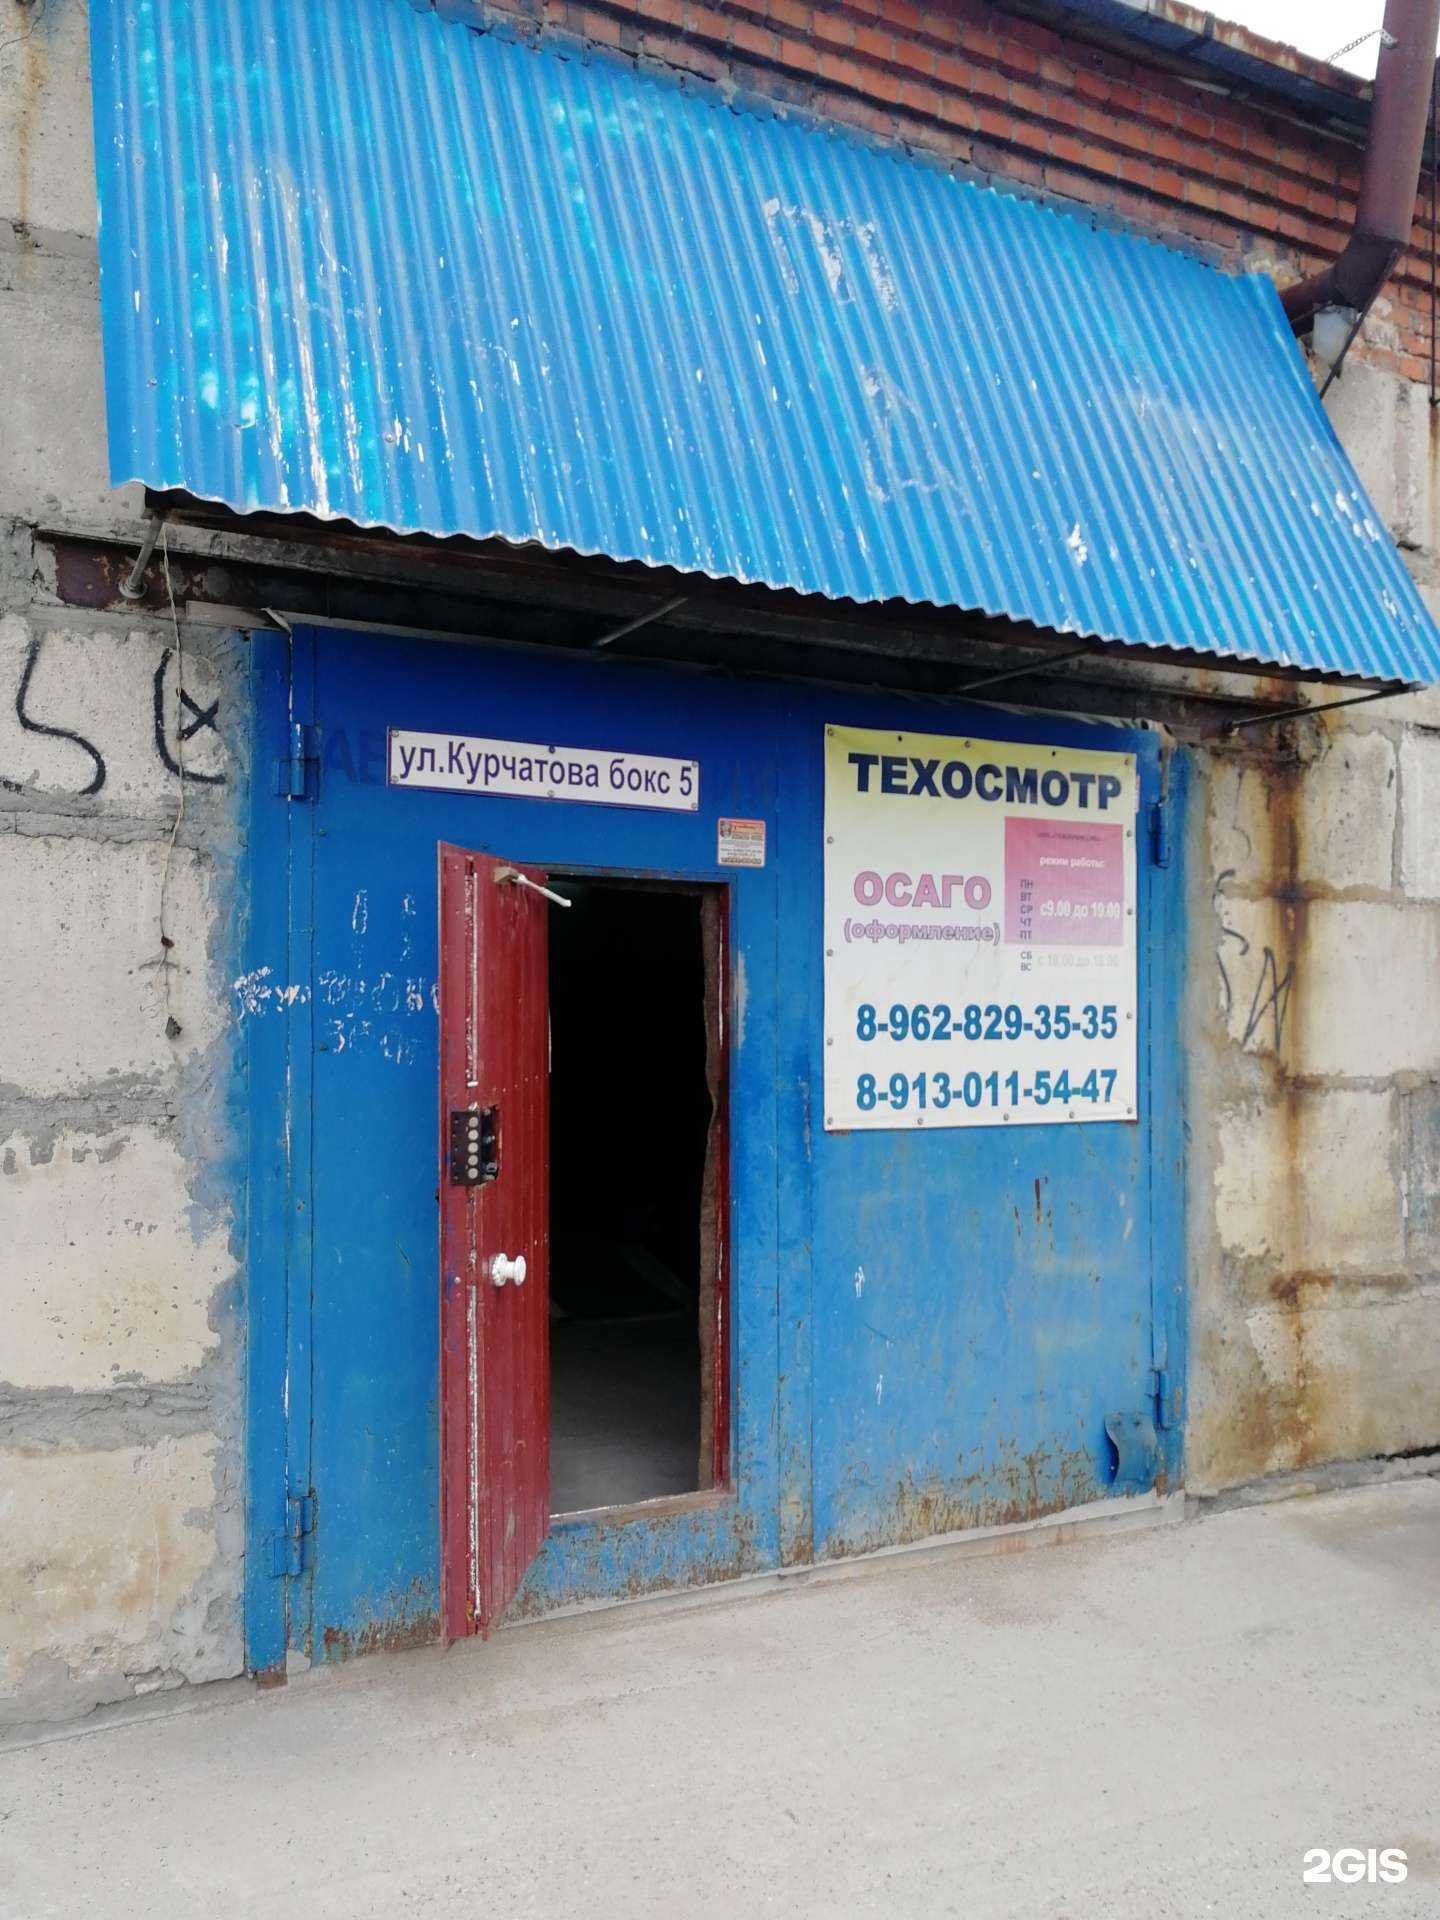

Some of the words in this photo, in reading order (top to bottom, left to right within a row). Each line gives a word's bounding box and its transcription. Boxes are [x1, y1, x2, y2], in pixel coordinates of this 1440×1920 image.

[399, 741, 599, 787] ул.Курчатова
[609, 757, 671, 795] бокс
[679, 766, 692, 796] 5
[848, 752, 1122, 810] ТЕХОСМОТР
[1020, 879, 1033, 889] ПН
[853, 871, 993, 911] ОСАГО
[1020, 892, 1032, 902] ВТ
[1020, 905, 1033, 914] СР
[1073, 904, 1088, 920] до
[1020, 918, 1032, 927] ЧТ
[844, 917, 1001, 945] (оформление)
[1020, 930, 1032, 940] ПТ
[1020, 951, 1032, 960] СБ
[1020, 962, 1032, 972] ВС
[856, 1004, 1118, 1041] 8-962-829-35-35
[856, 1068, 1118, 1111] 8-913-011-54-47
